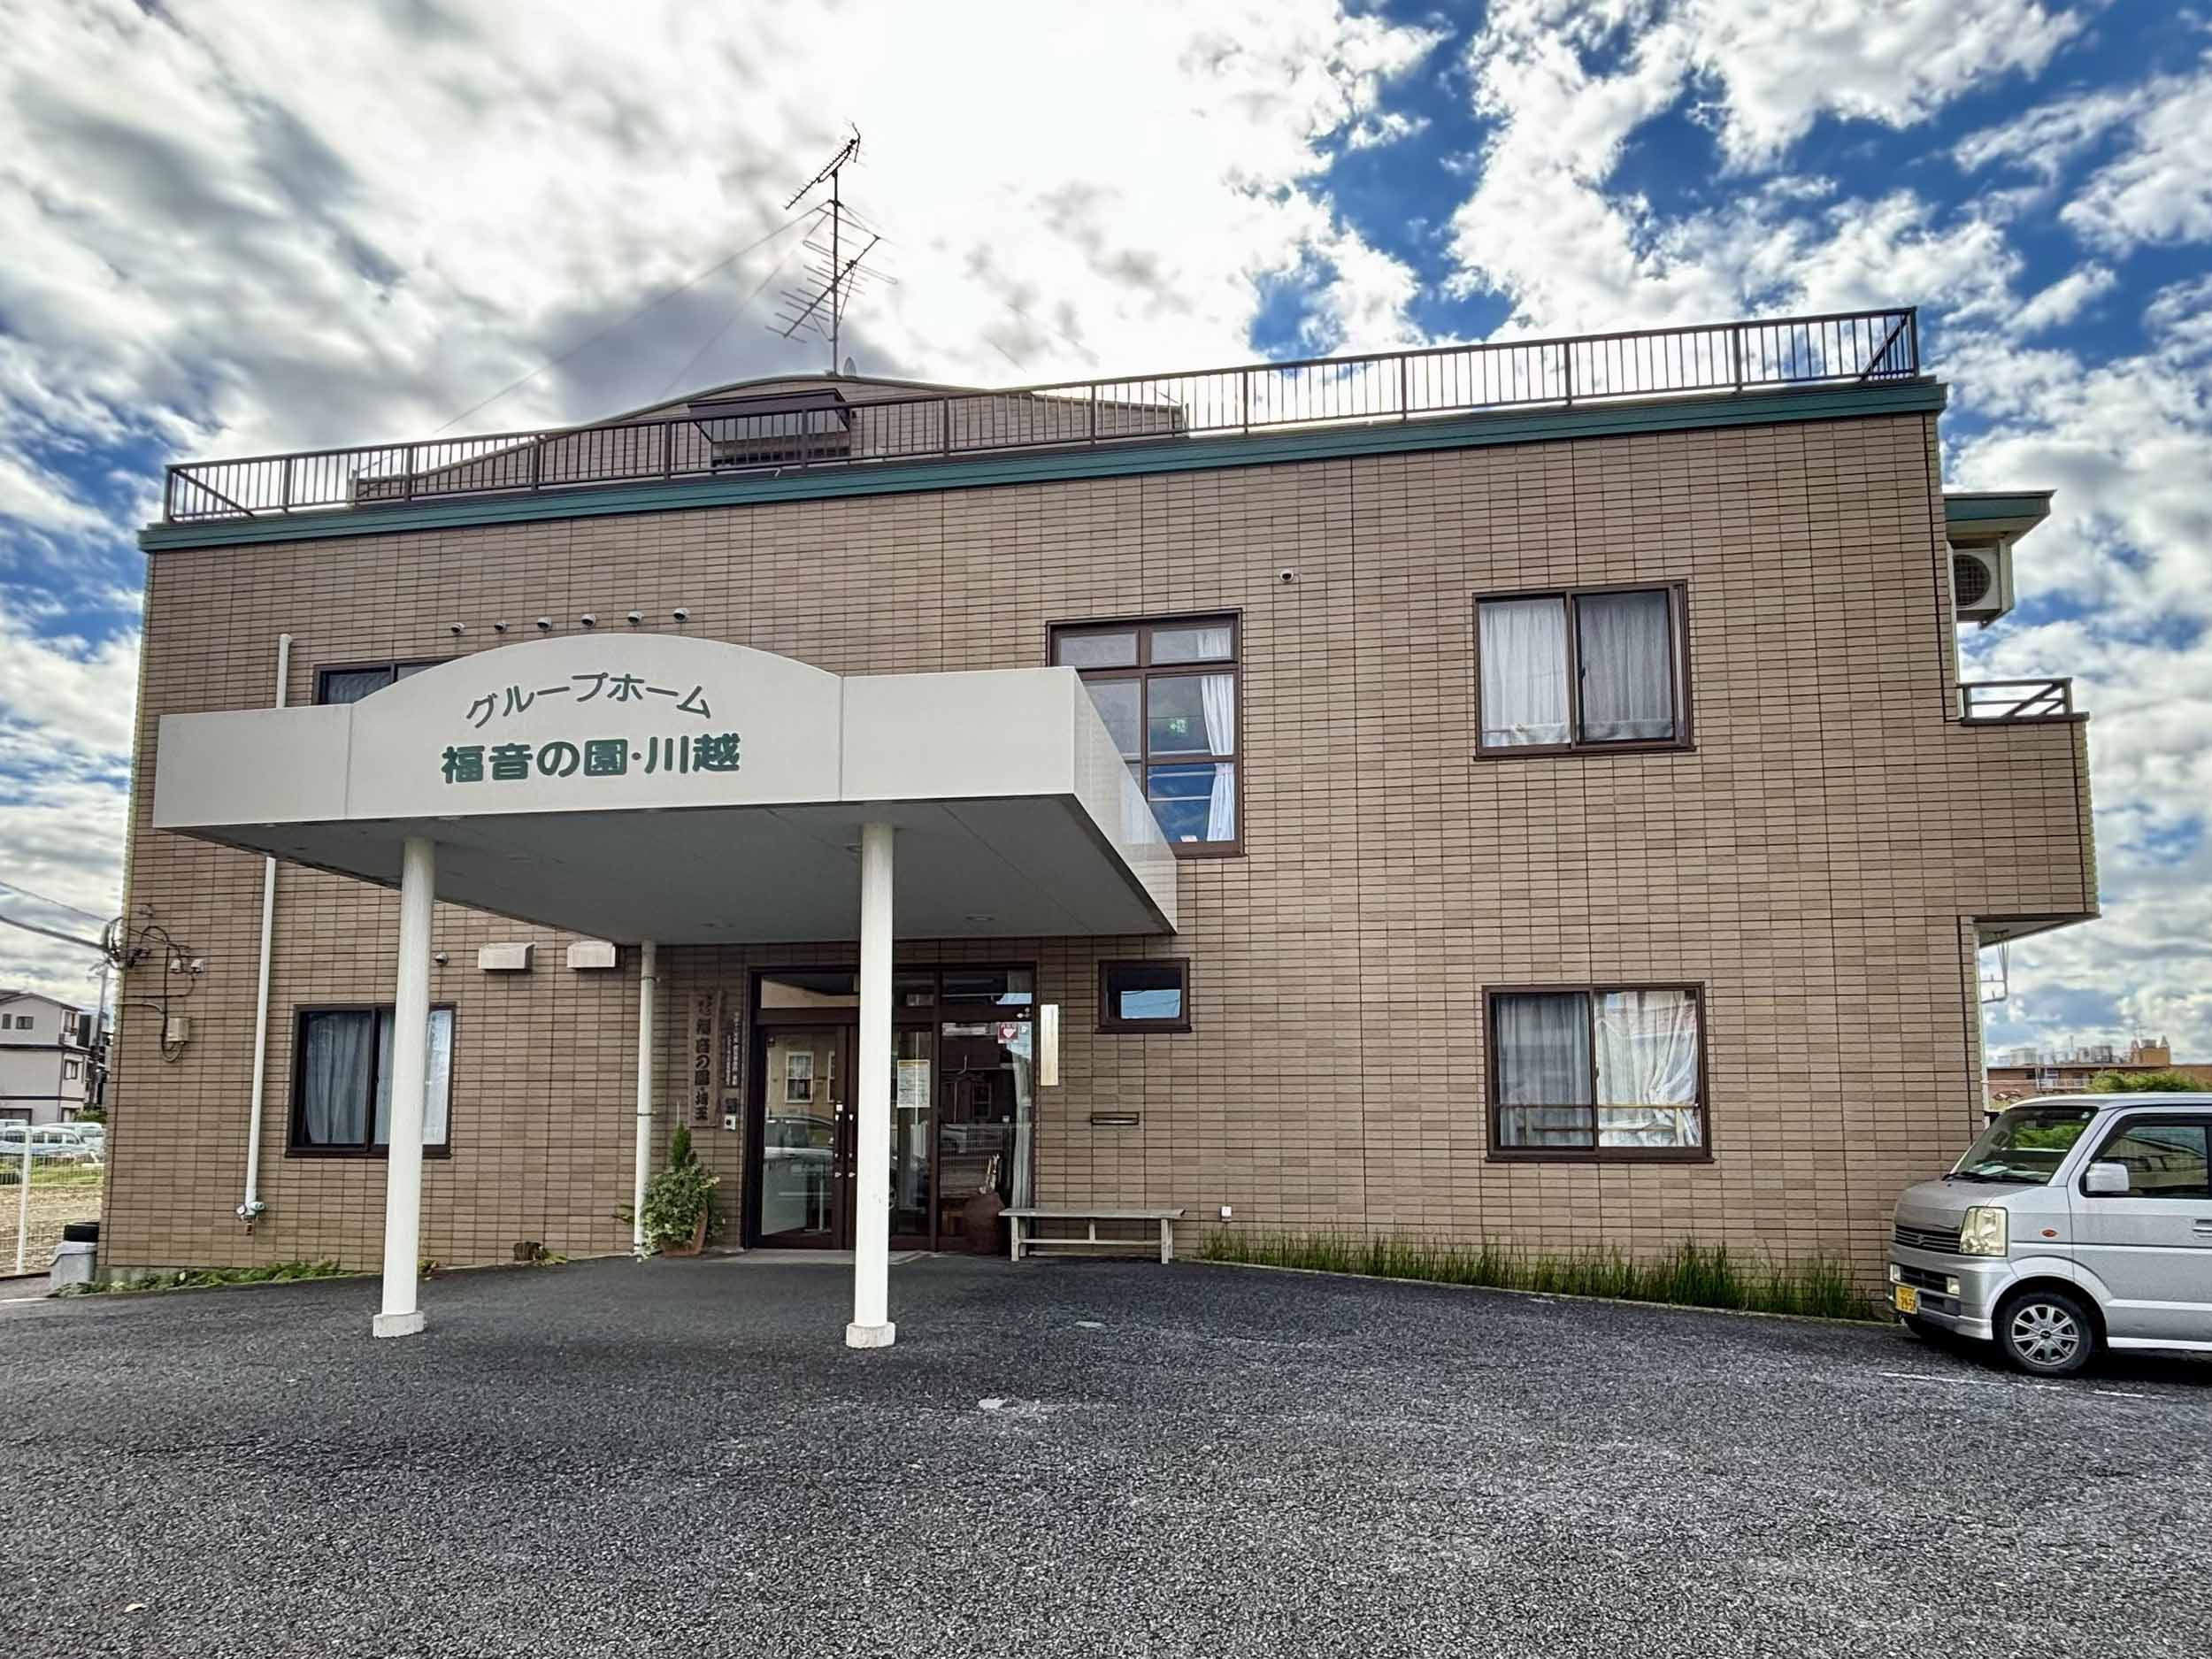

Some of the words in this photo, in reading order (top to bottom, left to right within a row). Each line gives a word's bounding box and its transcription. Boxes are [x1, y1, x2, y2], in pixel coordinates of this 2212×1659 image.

[465, 672, 711, 728] グループホーム
[442, 733, 740, 783] 福音の園・川越
